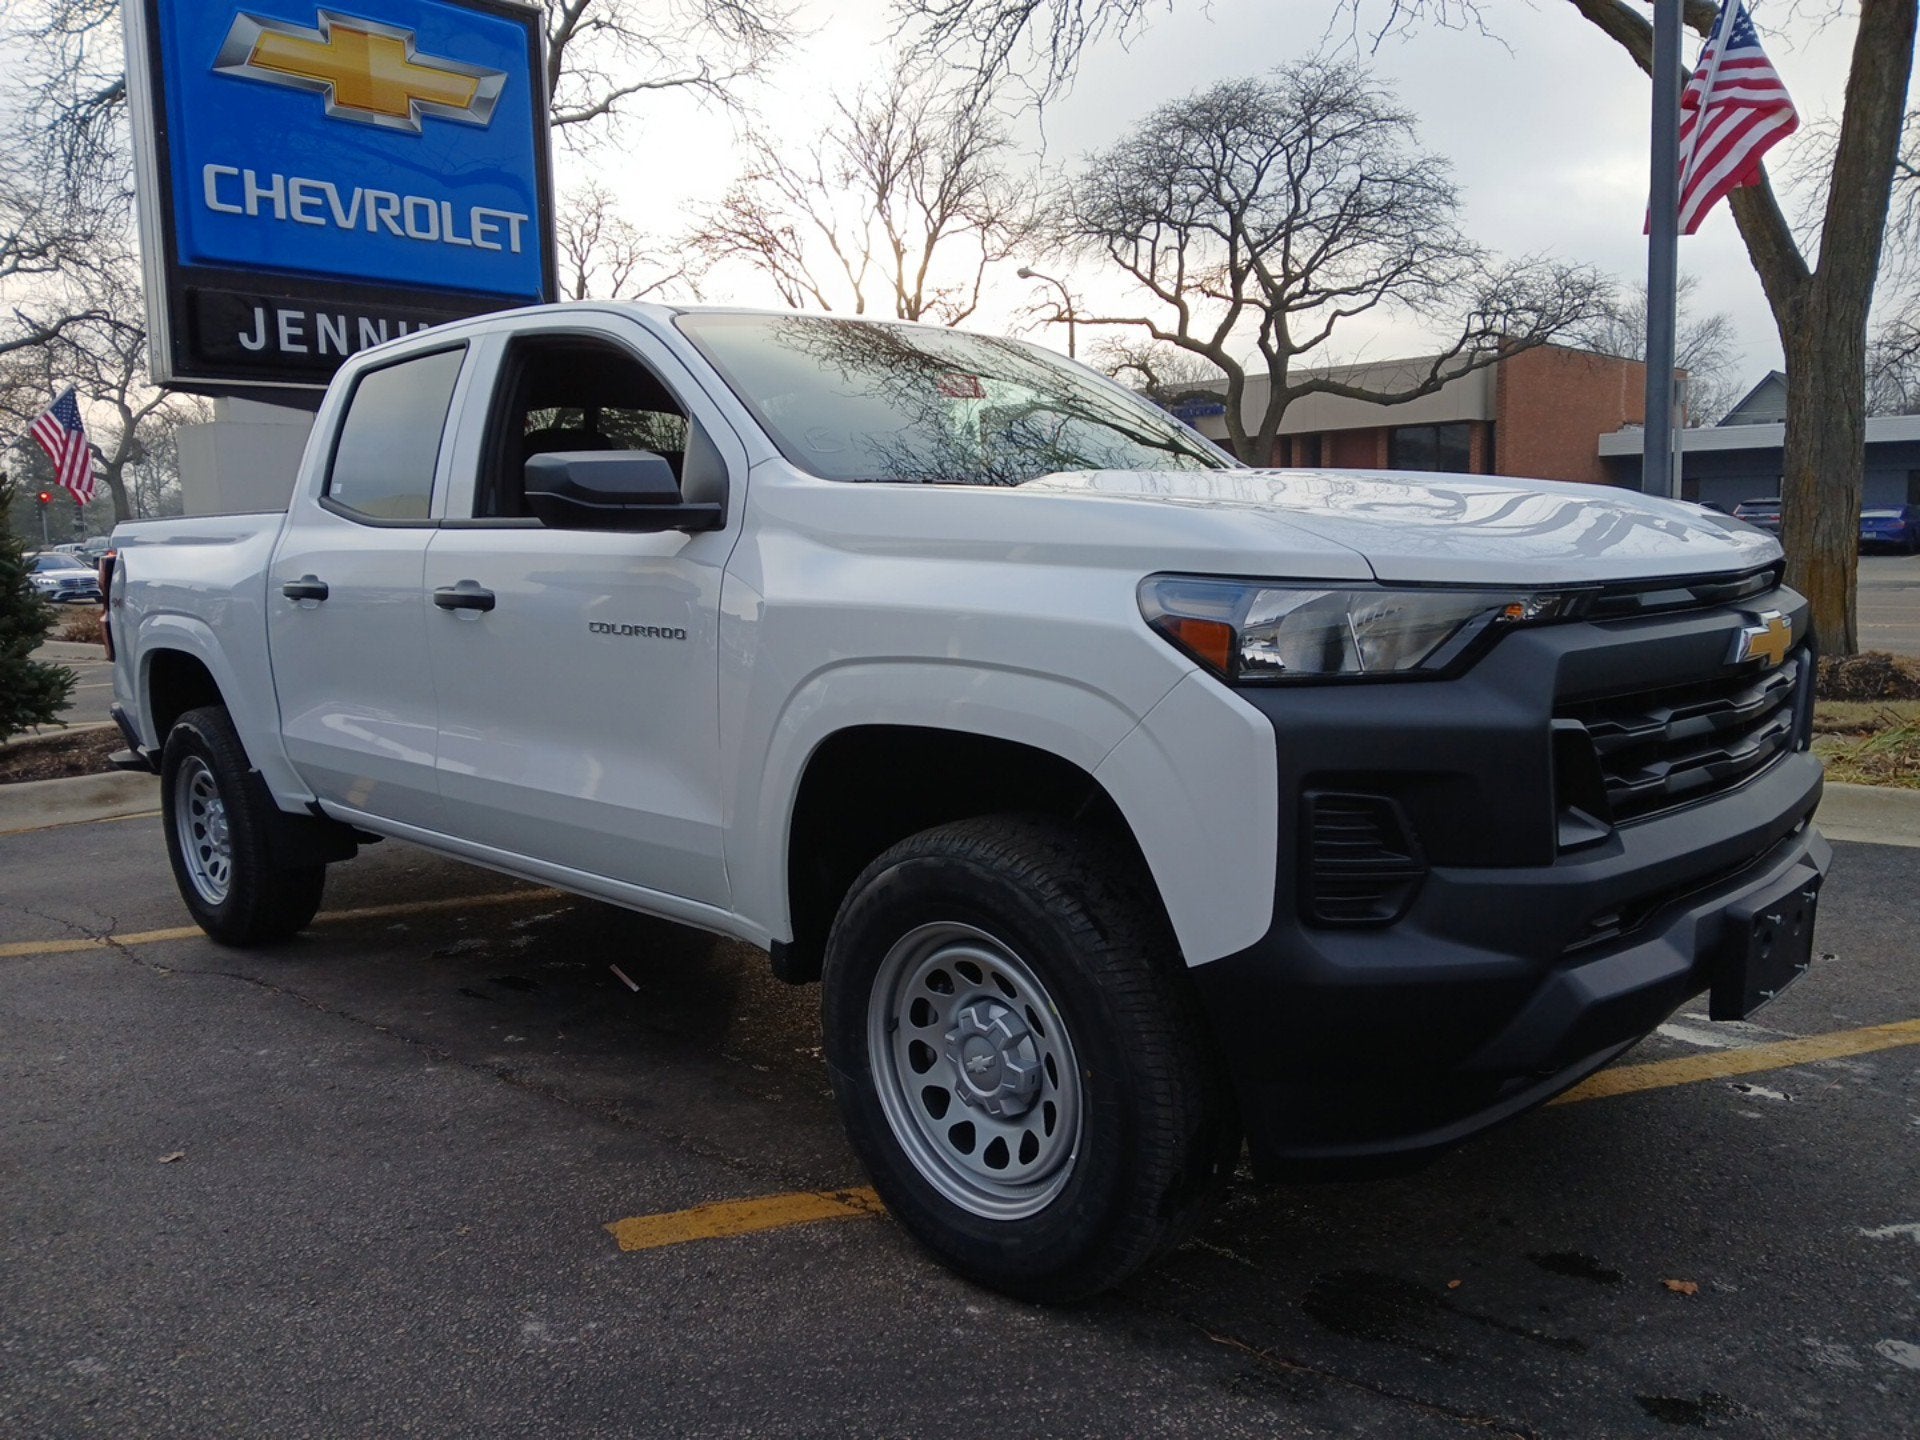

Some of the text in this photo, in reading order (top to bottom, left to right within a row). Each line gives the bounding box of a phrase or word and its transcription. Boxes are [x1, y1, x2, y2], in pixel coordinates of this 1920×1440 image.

[203, 163, 529, 253] CHEVROLET
[238, 307, 429, 356] JENN
[588, 621, 687, 640] COLORADO
